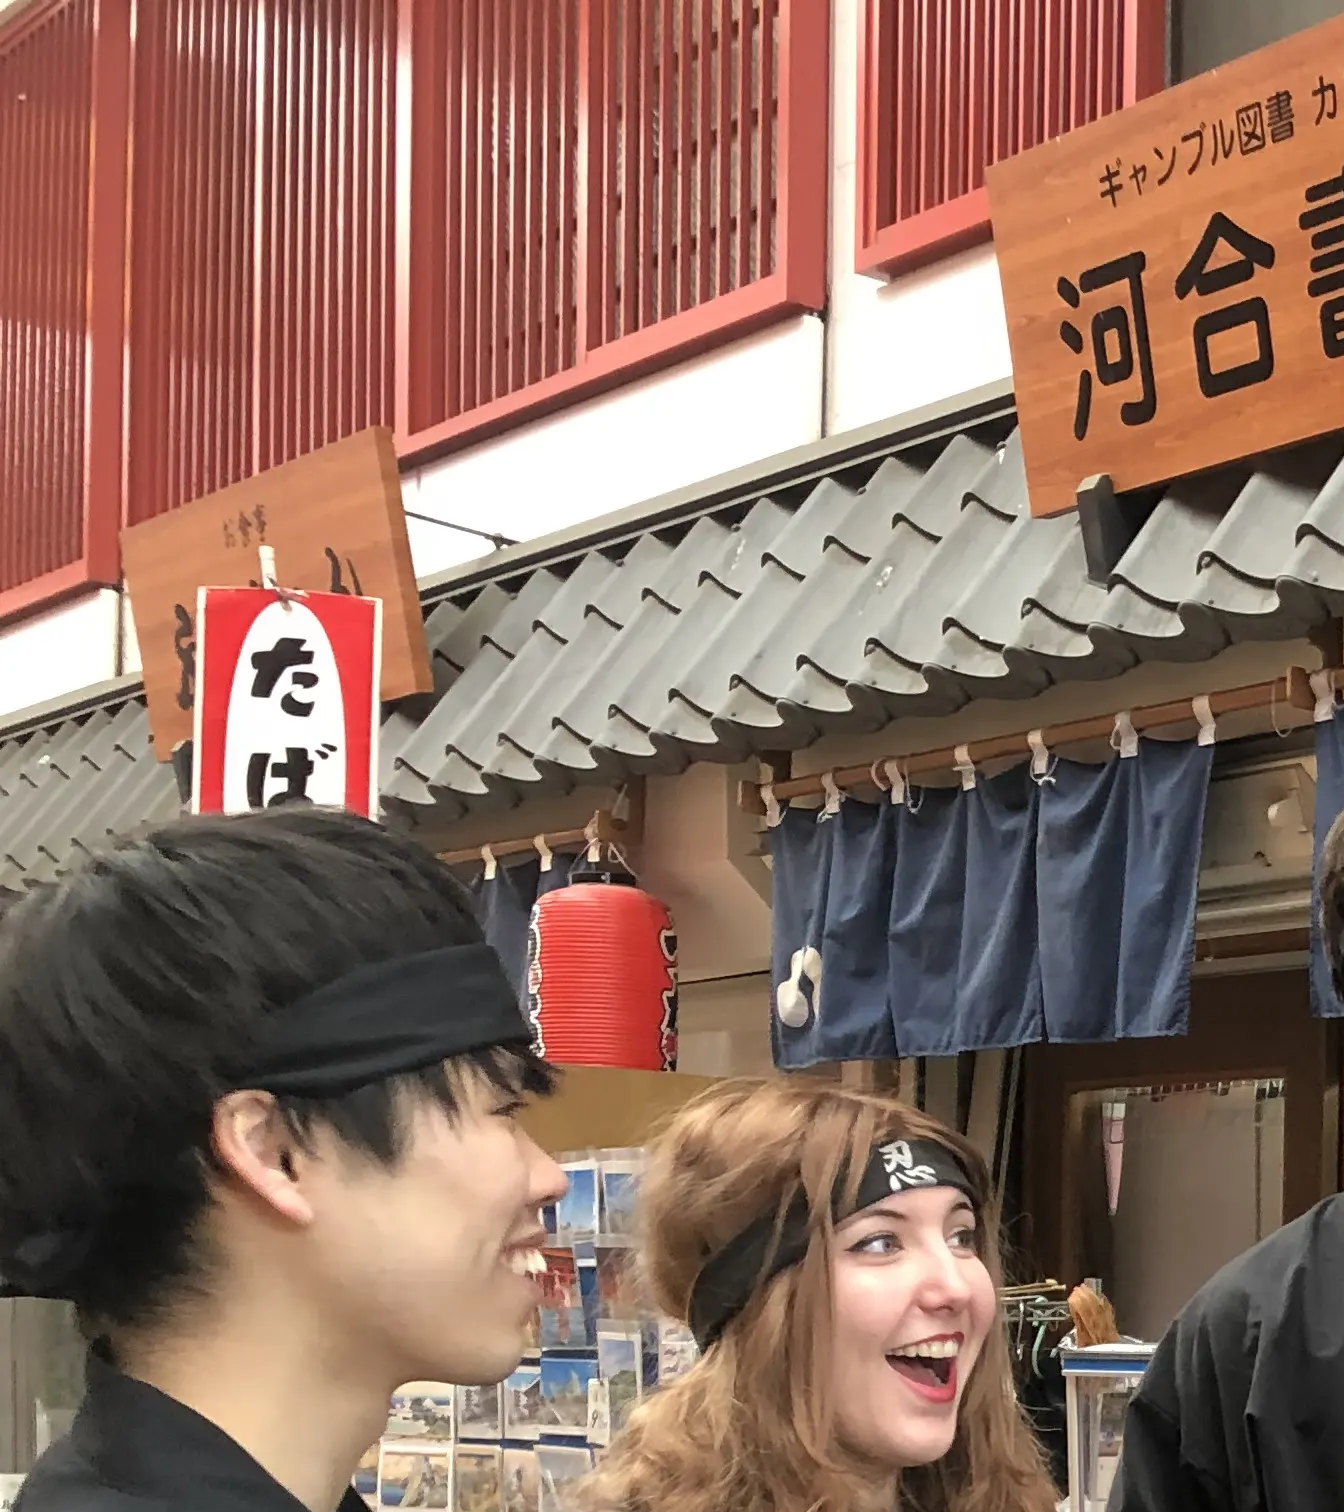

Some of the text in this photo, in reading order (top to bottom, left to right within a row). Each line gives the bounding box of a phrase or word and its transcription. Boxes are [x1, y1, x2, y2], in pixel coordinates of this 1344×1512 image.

[1098, 90, 1296, 208] ギャンブル図書
[878, 1140, 937, 1192] 忍
